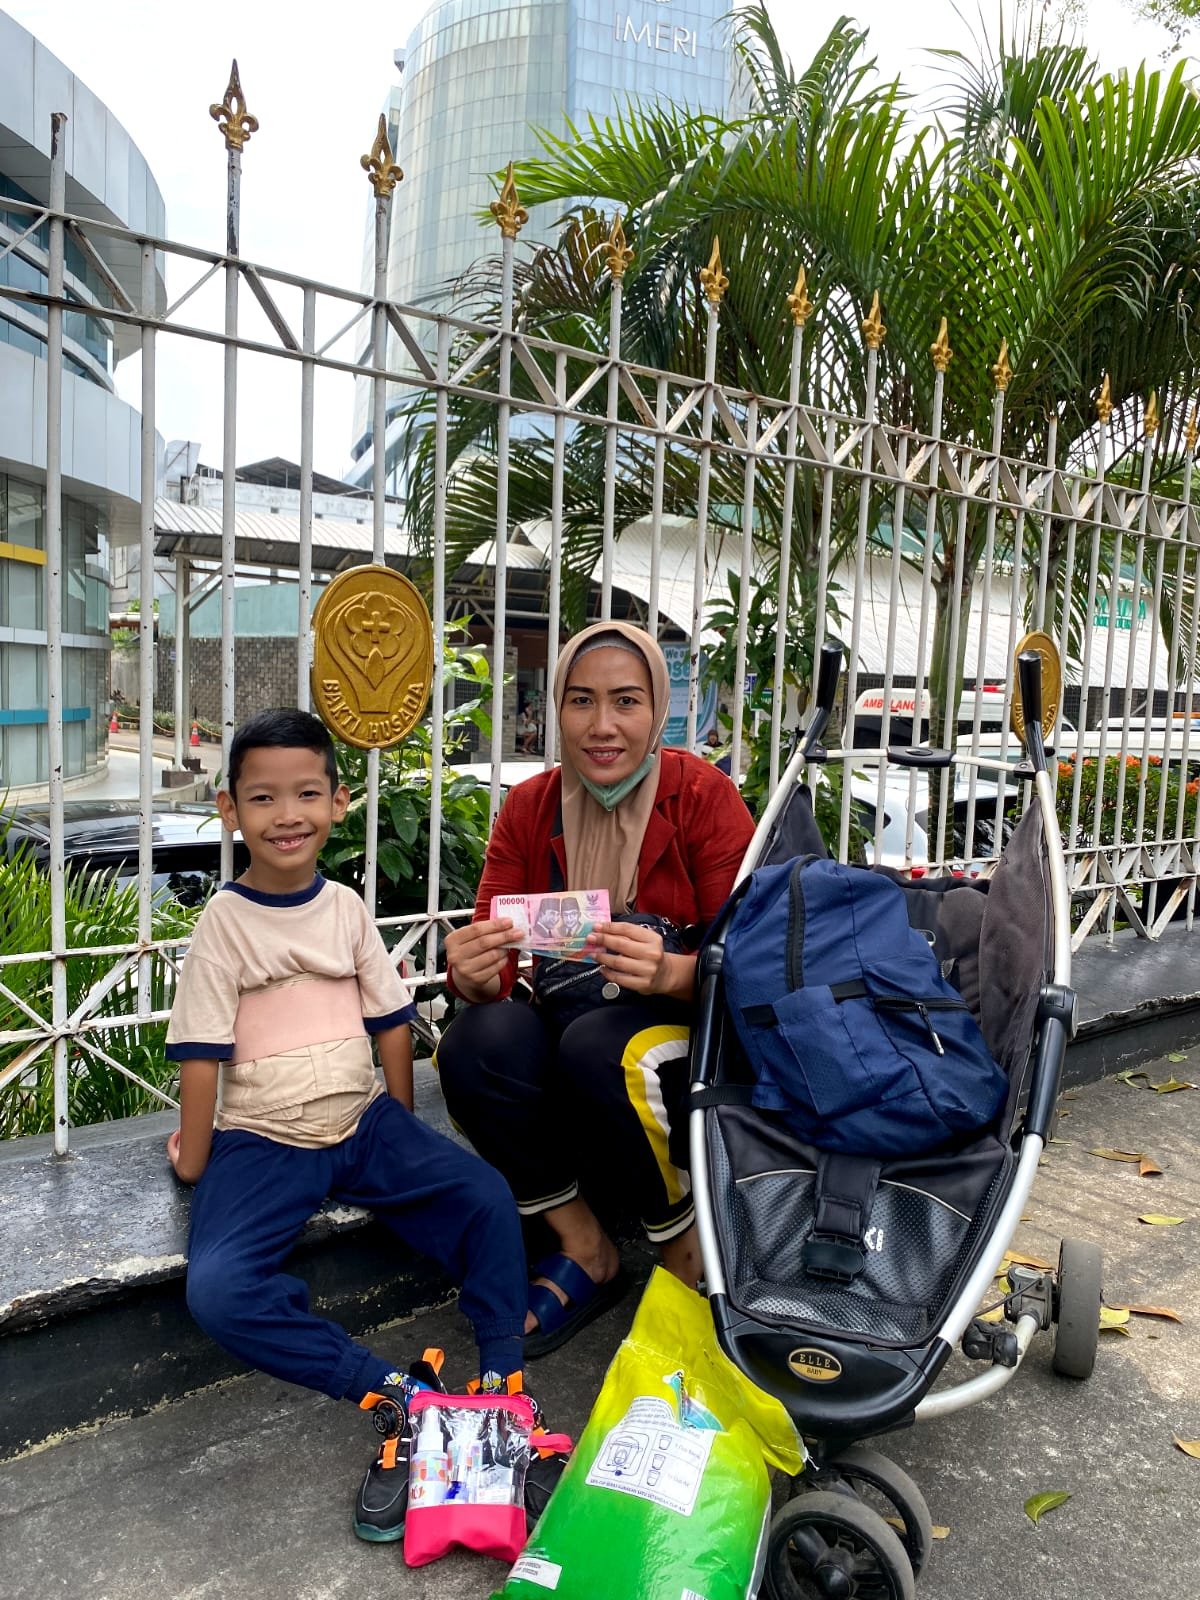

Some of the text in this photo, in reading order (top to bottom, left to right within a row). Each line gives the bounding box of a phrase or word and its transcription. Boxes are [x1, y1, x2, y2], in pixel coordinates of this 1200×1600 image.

[614, 13, 697, 58] IMERI
[322, 679, 424, 742] BAKTI HUSADA
[863, 698, 925, 711] AMBLANCE
[499, 897, 525, 905] 100000
[800, 1353, 831, 1368] ELLE
